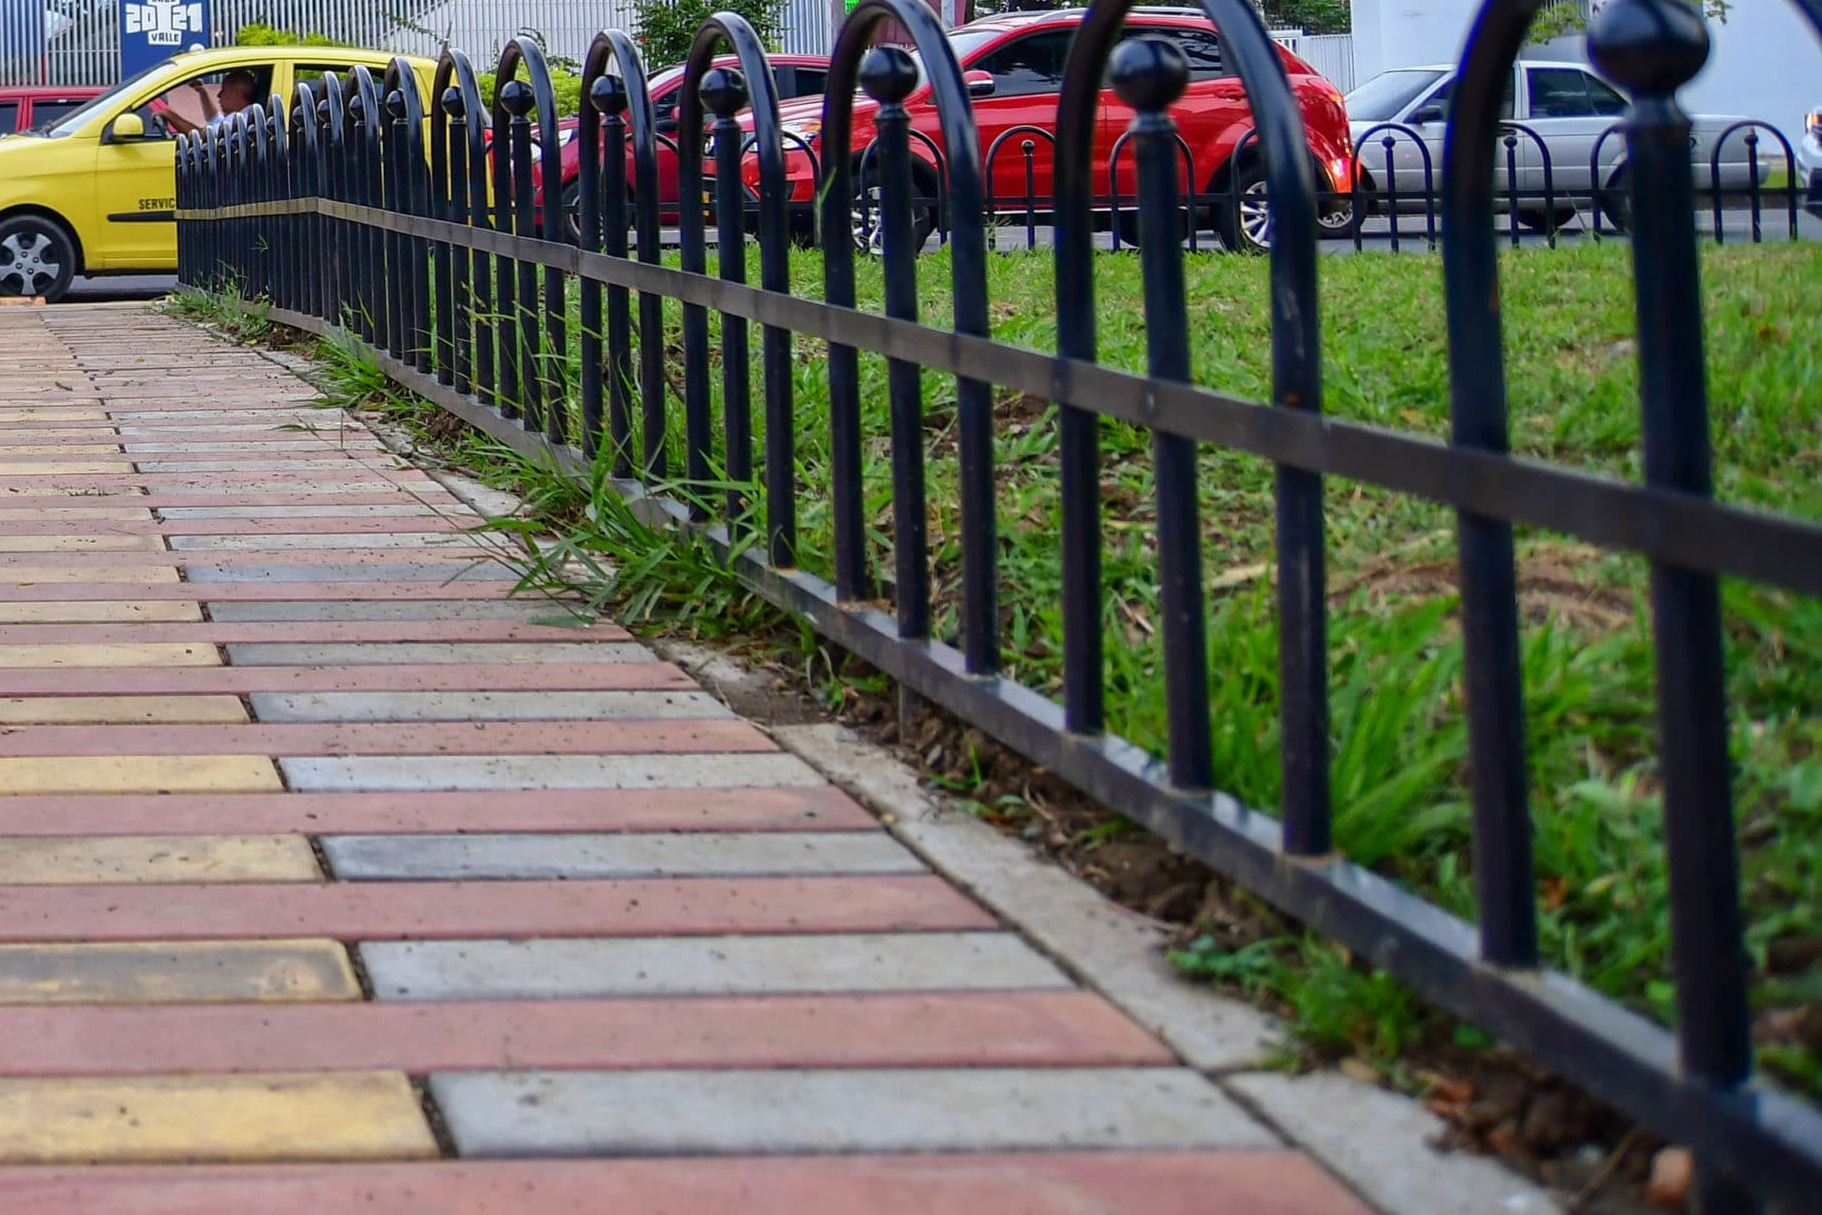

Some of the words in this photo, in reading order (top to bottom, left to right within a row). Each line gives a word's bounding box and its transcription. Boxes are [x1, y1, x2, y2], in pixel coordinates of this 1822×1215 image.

[125, 3, 203, 34] 2021
[151, 33, 179, 42] VALLE
[138, 197, 175, 210] SERVIC
